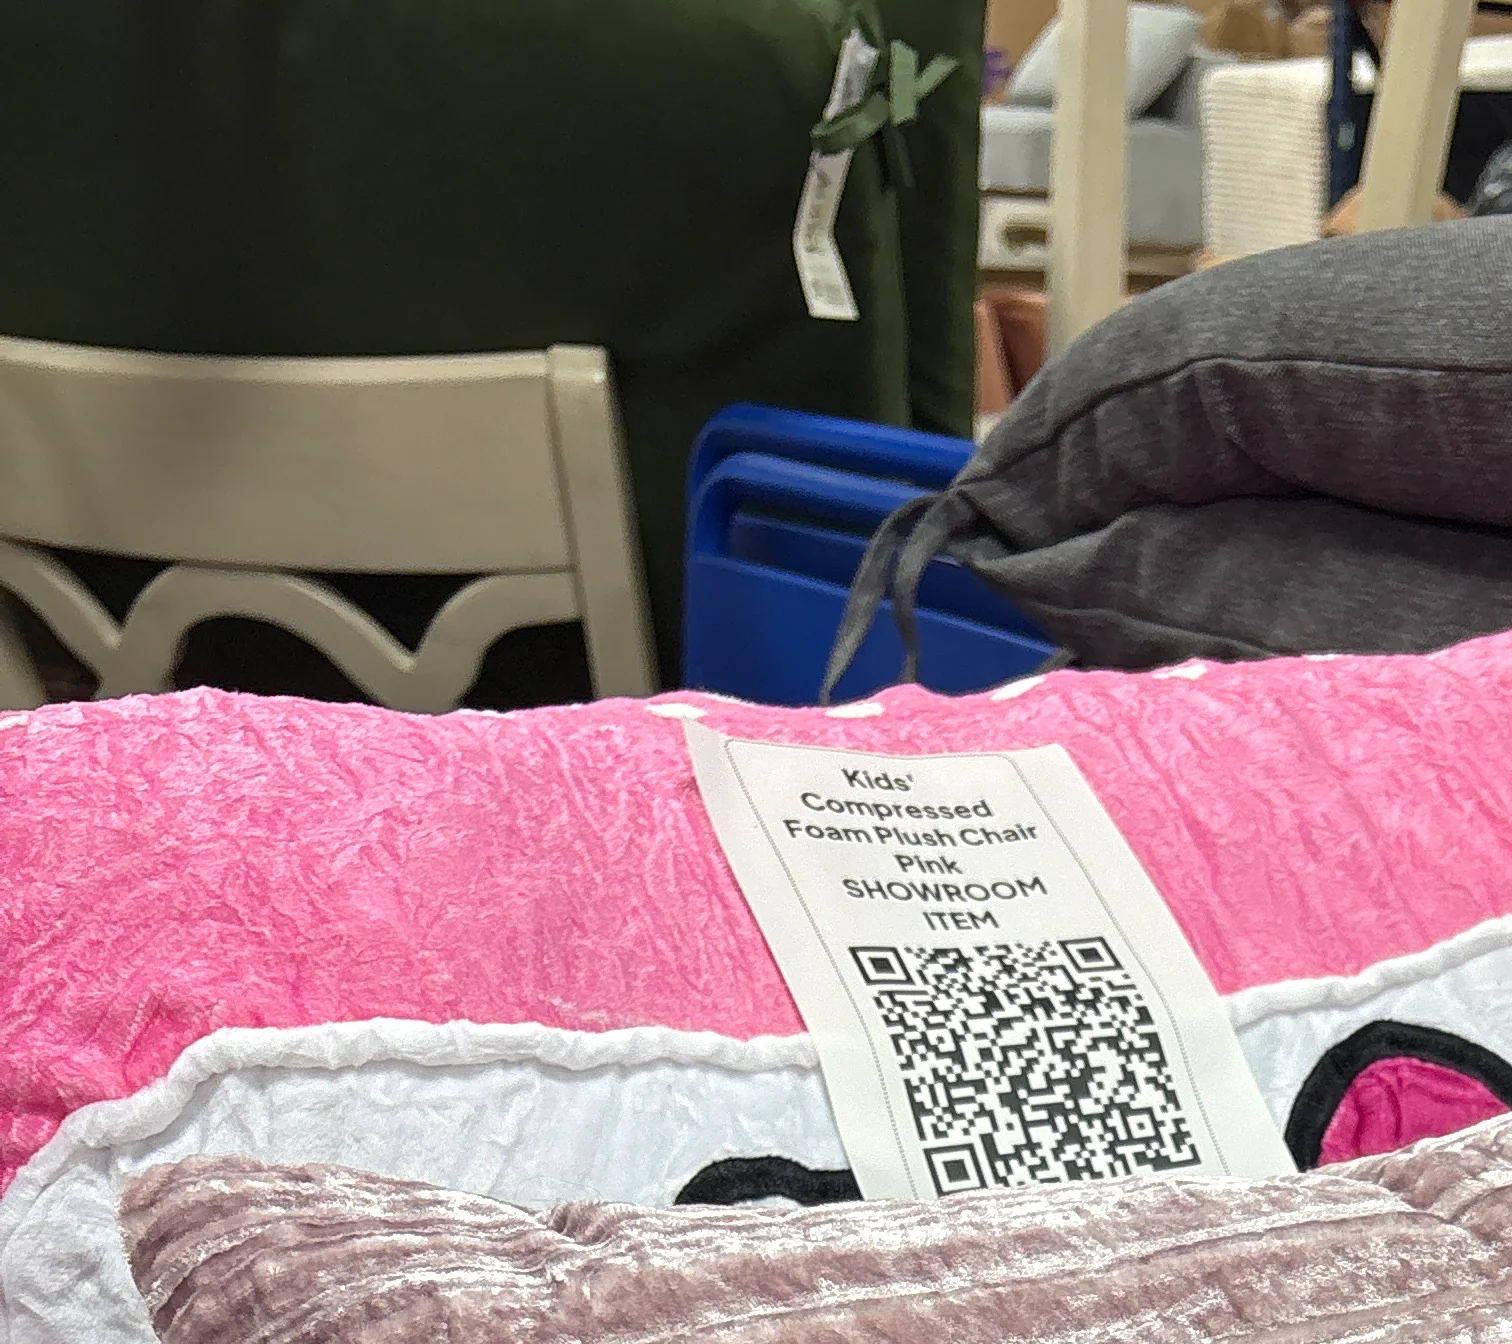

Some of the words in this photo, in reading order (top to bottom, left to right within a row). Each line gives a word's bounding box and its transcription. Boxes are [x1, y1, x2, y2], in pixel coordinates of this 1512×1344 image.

[841, 768, 913, 791] Kids'
[800, 792, 992, 821] Compressed
[783, 819, 872, 843] Foam
[872, 826, 957, 847] Plush
[959, 824, 1037, 846] Chair
[894, 854, 963, 874] Pink
[842, 877, 1048, 902] SHOWROOM
[922, 910, 999, 930] ITEM
